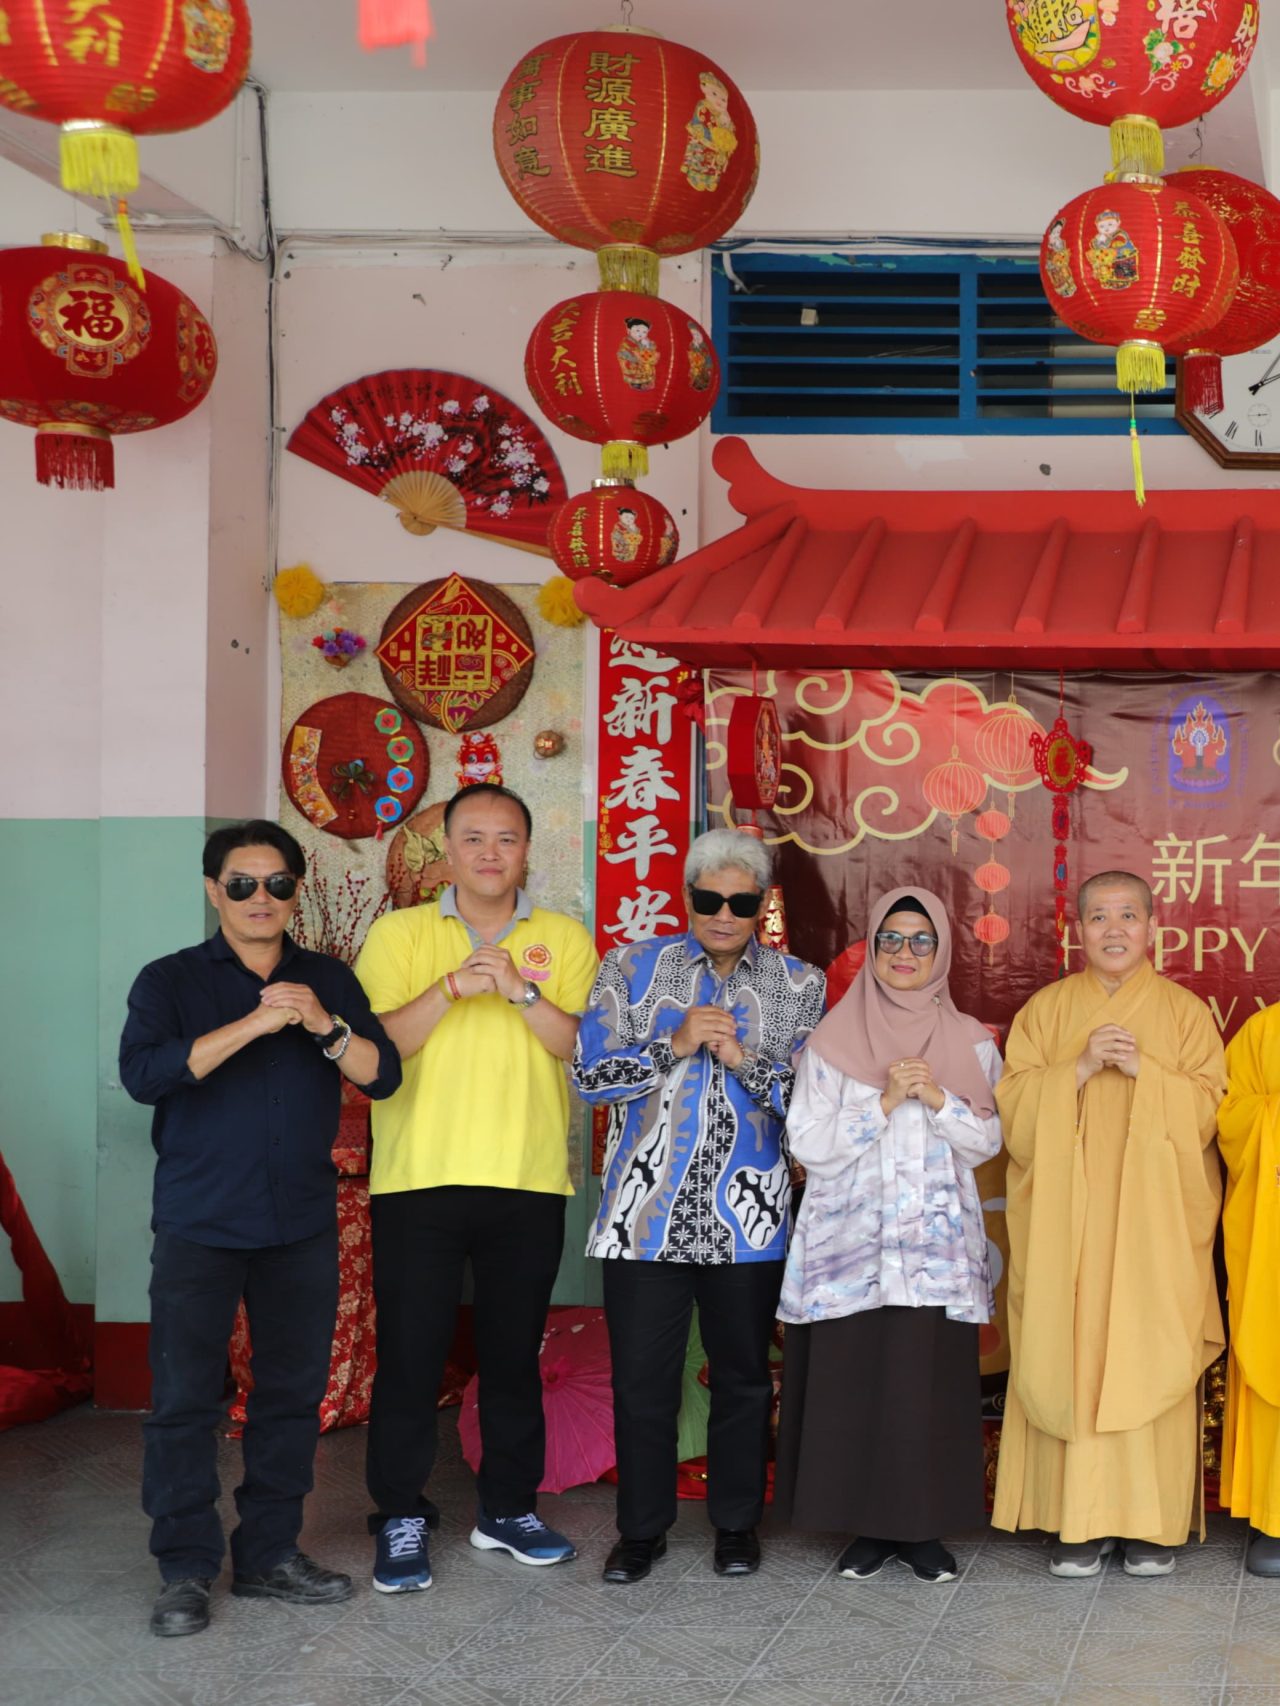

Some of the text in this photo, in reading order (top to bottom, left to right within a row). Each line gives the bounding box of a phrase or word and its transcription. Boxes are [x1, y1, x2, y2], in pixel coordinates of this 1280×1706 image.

[583, 51, 640, 178] 財源廣進
[1171, 201, 1206, 298] 恭喜發財
[59, 290, 125, 342] 福
[551, 302, 583, 396] 大吉大利
[1063, 926, 1269, 973] HPPY
